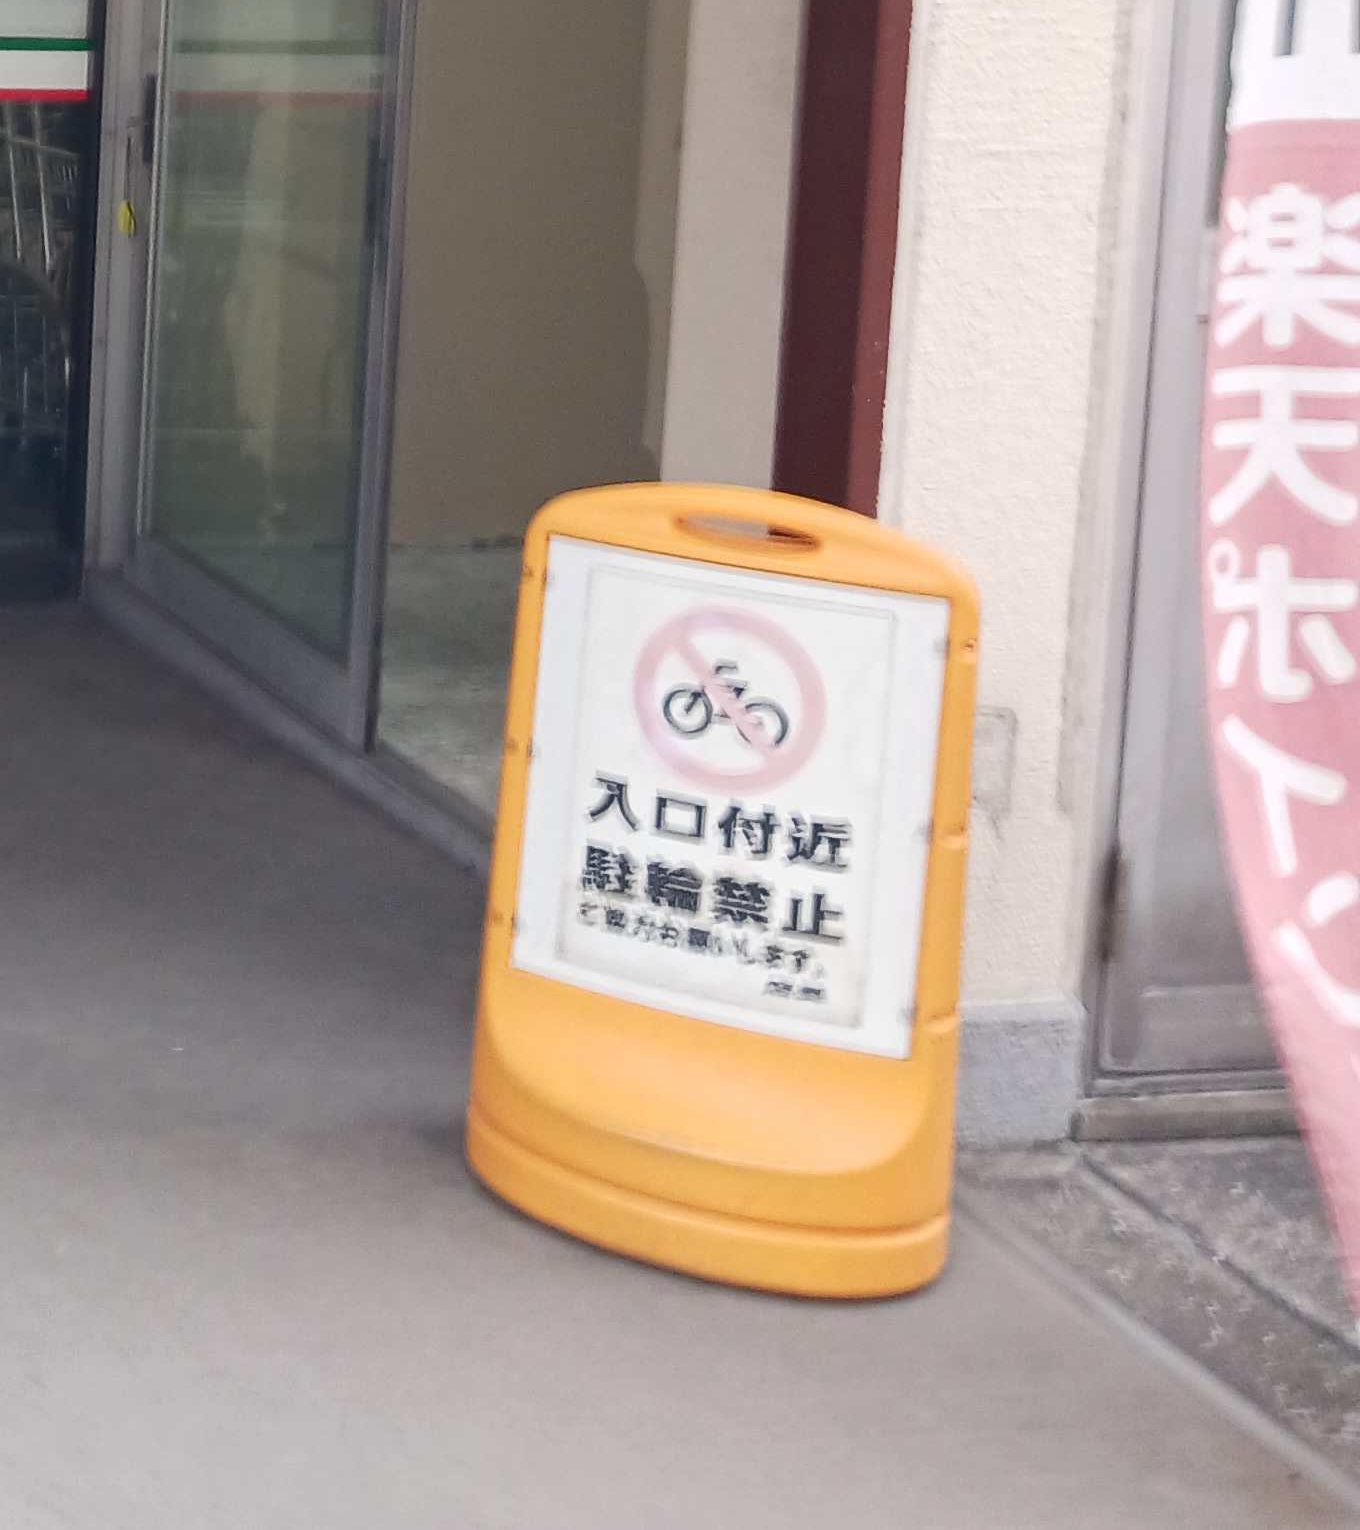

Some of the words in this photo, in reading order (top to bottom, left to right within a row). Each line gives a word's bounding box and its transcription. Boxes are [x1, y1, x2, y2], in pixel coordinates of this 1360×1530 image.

[584, 773, 855, 872] 入口付近
[580, 843, 846, 942] 駐輪禁止
